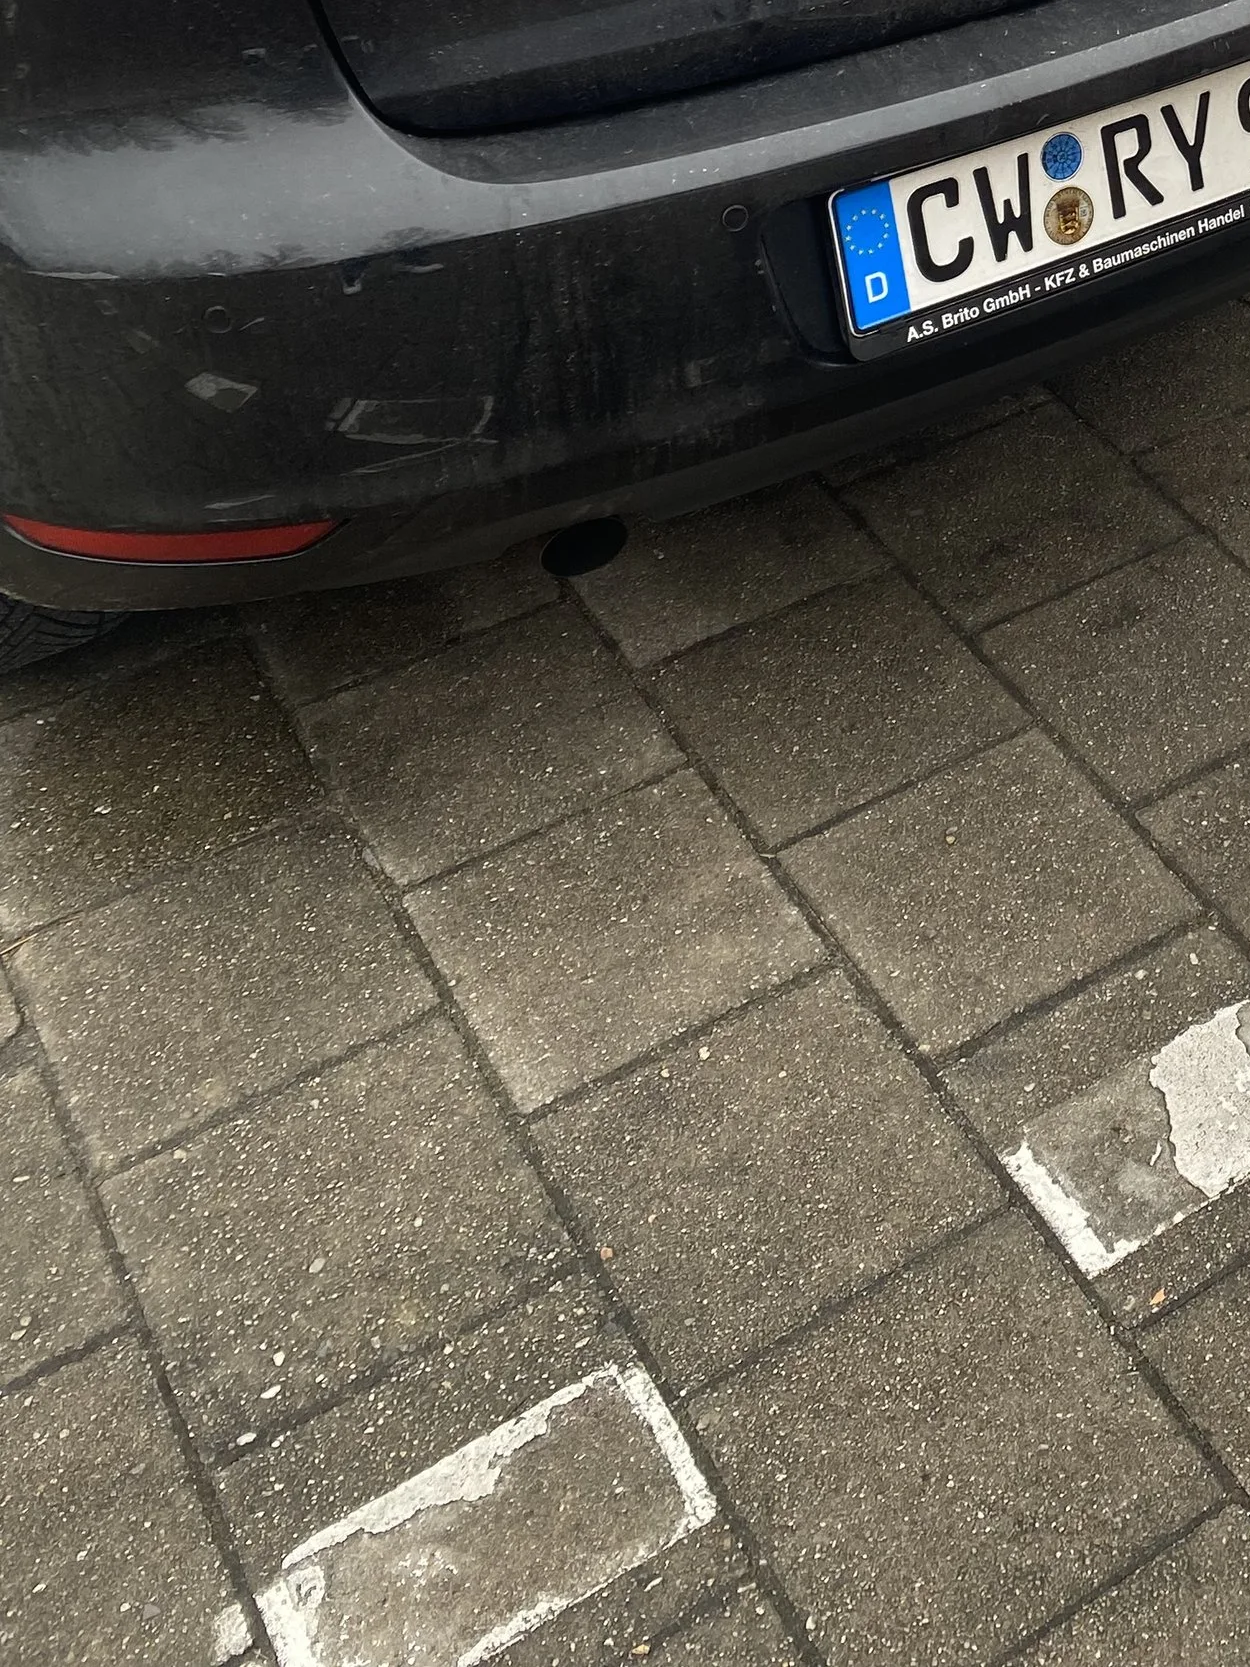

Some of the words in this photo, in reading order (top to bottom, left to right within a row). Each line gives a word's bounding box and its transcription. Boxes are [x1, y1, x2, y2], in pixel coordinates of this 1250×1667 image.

[906, 152, 1034, 283] CW
[1100, 90, 1210, 220] RY
[864, 271, 889, 304] D
[906, 318, 939, 342] A.S.
[941, 306, 980, 329] Brito
[982, 283, 1031, 314] GmbH
[1044, 268, 1077, 291] KFZ
[1078, 262, 1091, 279] &
[1092, 222, 1196, 273] Baumaschinen
[1197, 204, 1245, 235] Handel
